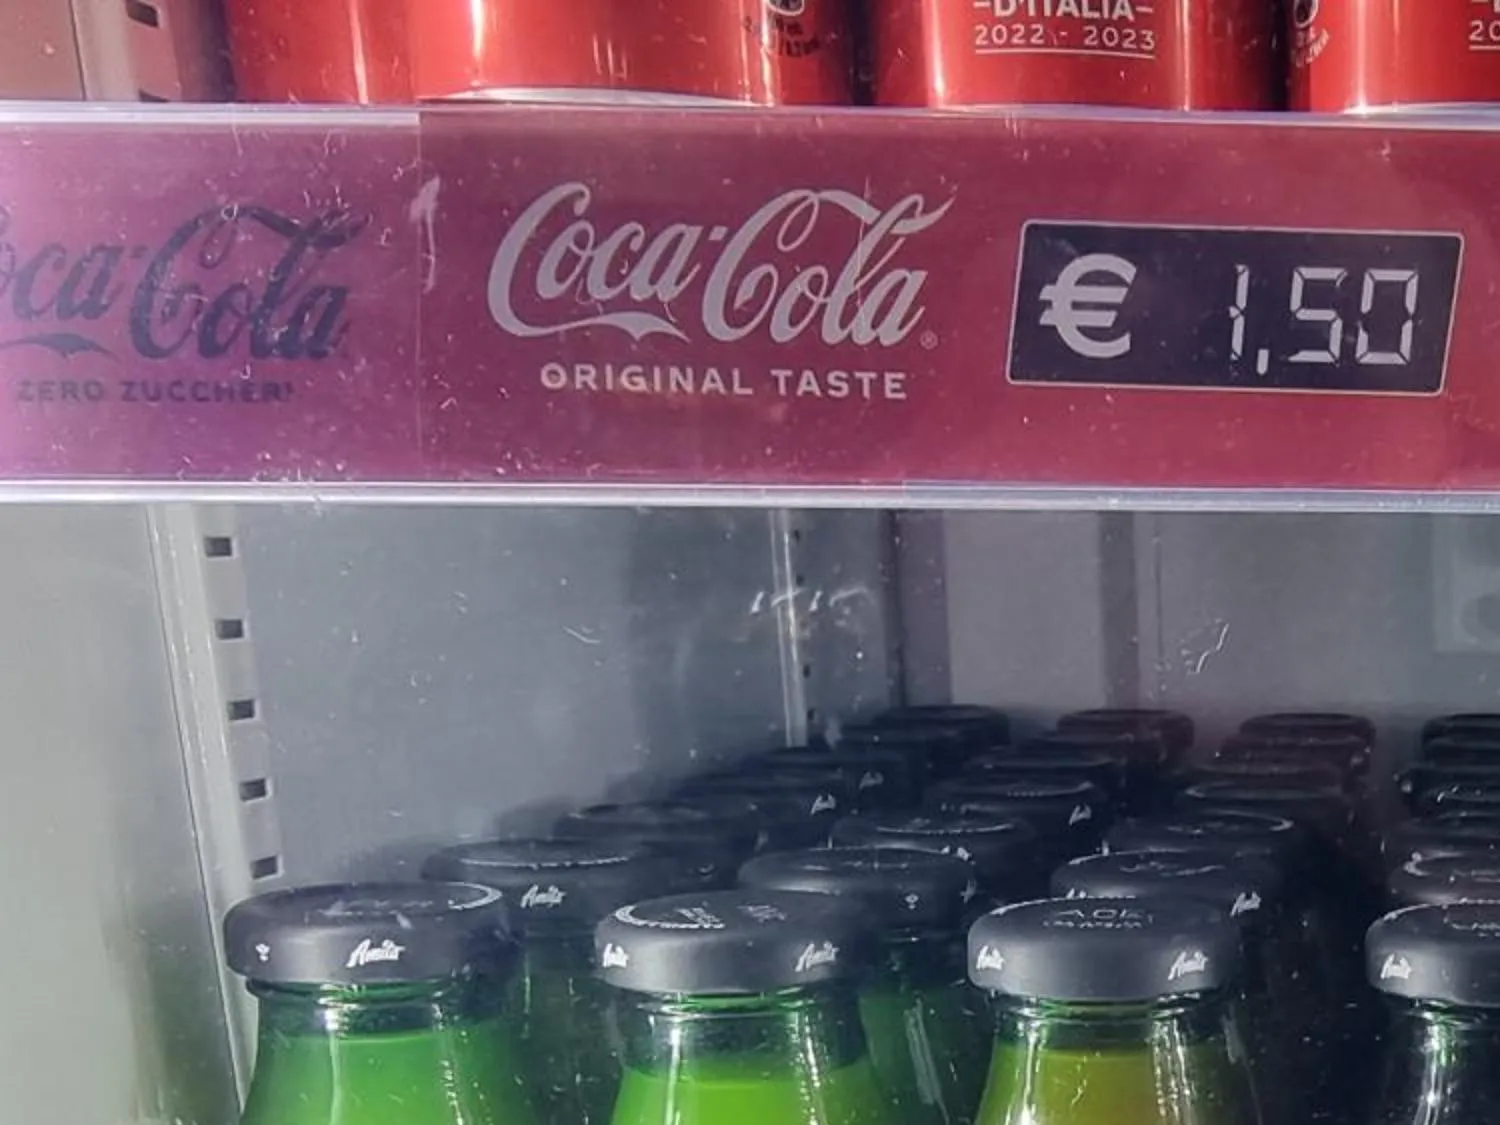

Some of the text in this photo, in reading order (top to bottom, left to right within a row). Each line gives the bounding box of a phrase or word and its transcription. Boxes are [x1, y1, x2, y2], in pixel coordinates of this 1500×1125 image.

[974, 23, 1045, 46] 2022
[1083, 25, 1156, 50] 2023
[1228, 263, 1421, 376] 1,50
[18, 380, 104, 402] ZERO
[540, 362, 907, 399] ORIGINAL TASTE
